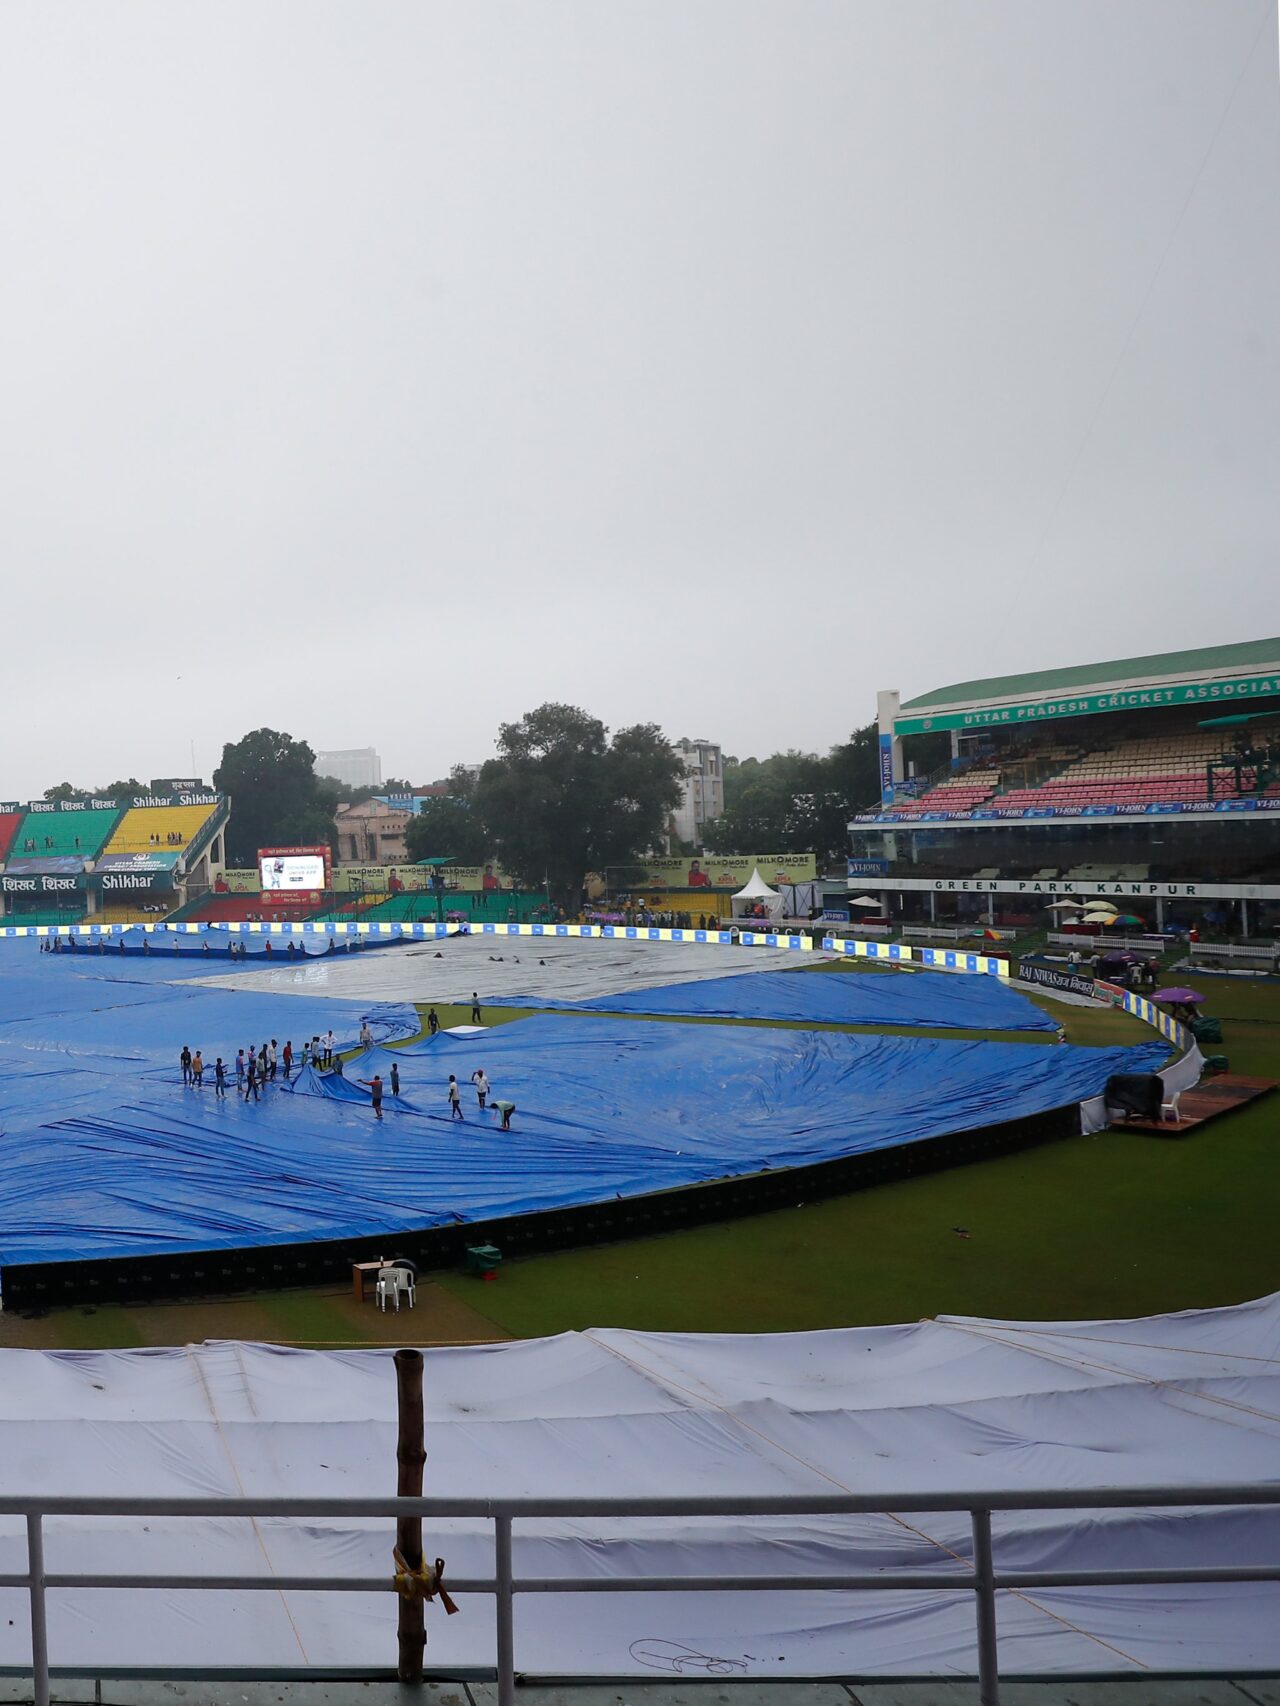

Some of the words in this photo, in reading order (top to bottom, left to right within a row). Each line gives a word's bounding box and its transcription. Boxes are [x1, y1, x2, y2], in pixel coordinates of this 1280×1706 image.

[964, 711, 1010, 724] UTTAR
[1018, 700, 1088, 718] PRADESH
[1098, 691, 1174, 708] CRICKET
[882, 753, 891, 786] VI-JOHN
[133, 796, 172, 808] Shikhar
[180, 794, 219, 805] Shikhar
[1054, 807, 1082, 815] VI-JOHN
[1116, 804, 1147, 813] VI-JOHN
[1182, 802, 1216, 811] VI-JOHN
[854, 863, 881, 872] VI-JOHN
[2, 877, 36, 891] शिखर
[42, 876, 77, 890] शिखर
[102, 874, 153, 889] Shikhar
[936, 881, 997, 890] GREEN
[1019, 882, 1073, 892] PARK
[1097, 884, 1196, 895] KANPUR
[1020, 964, 1032, 980] RAJ
[1034, 968, 1057, 984] NIWAS
[1070, 976, 1094, 993] निवास
